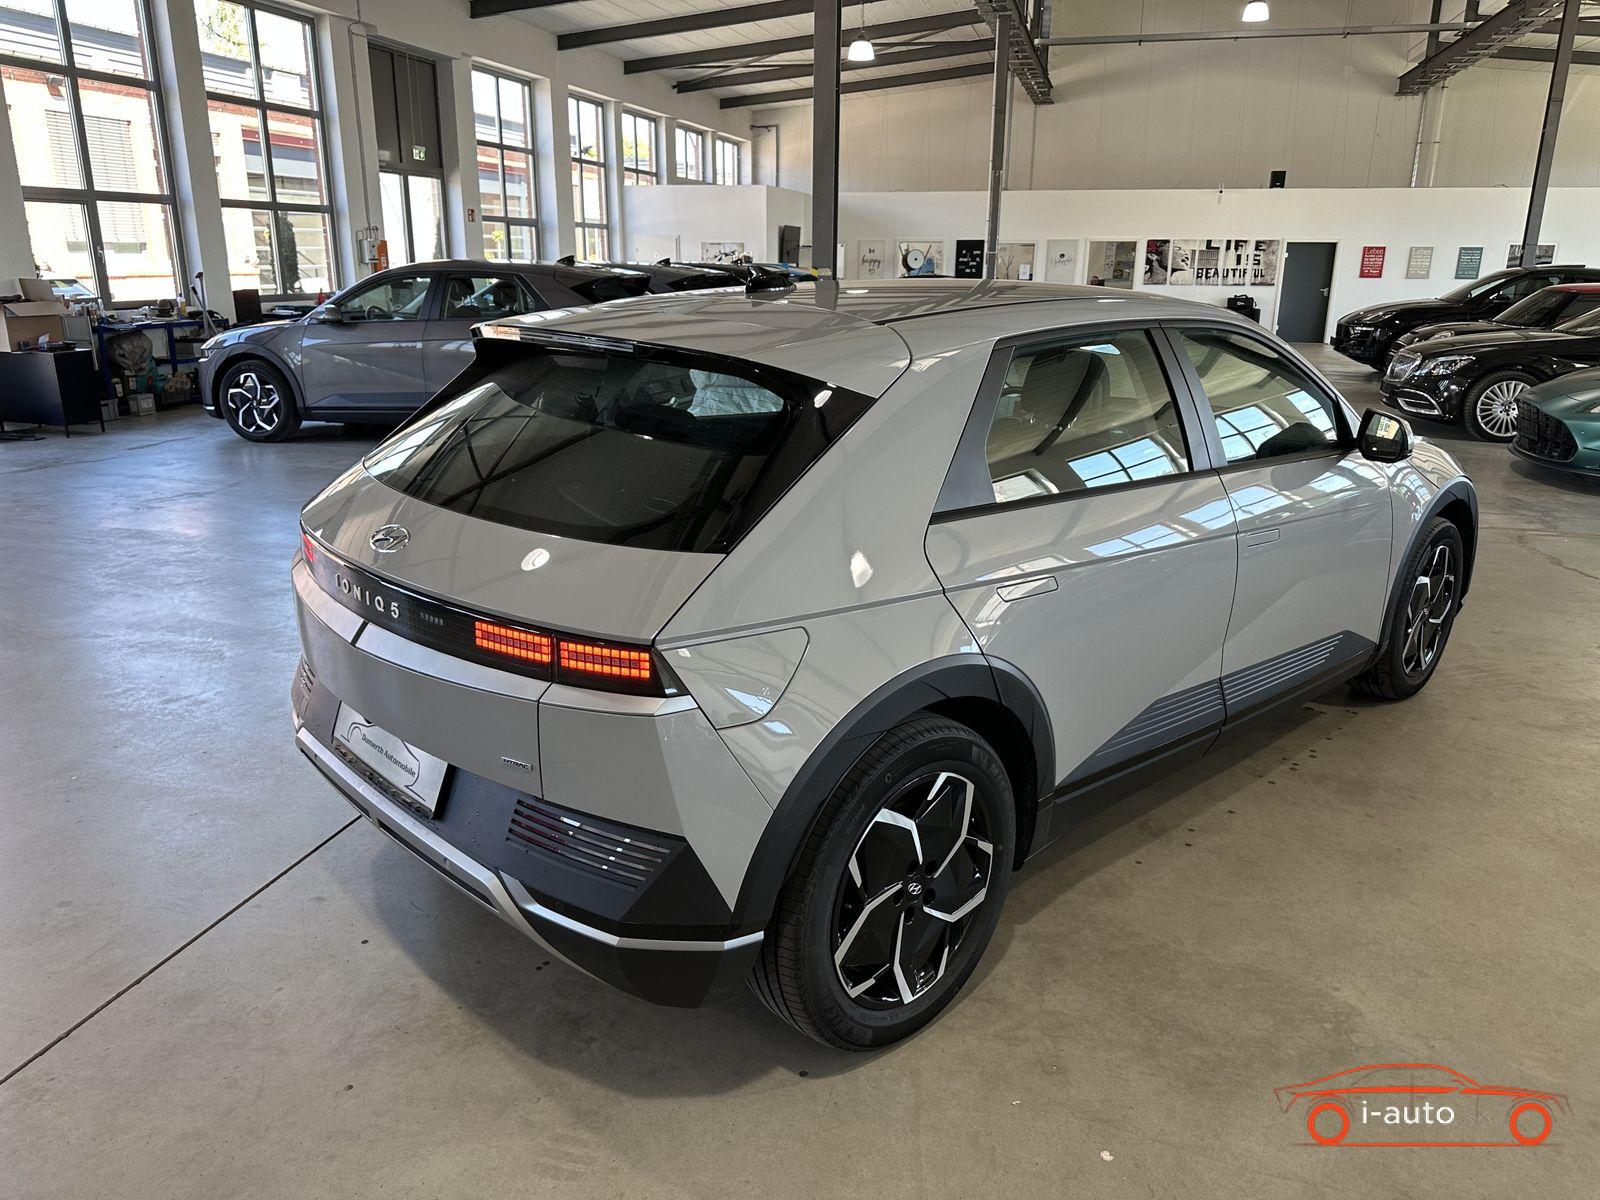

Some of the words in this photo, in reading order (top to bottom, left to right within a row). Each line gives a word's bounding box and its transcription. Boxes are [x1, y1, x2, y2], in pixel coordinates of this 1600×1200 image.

[1205, 240, 1267, 252] LIFE
[1365, 247, 1384, 255] Leben
[861, 254, 881, 269] happy
[1196, 268, 1265, 279] BEAUTIFUL
[335, 573, 385, 612] IONIQ
[390, 602, 400, 619] 5
[383, 750, 416, 778] Automobile
